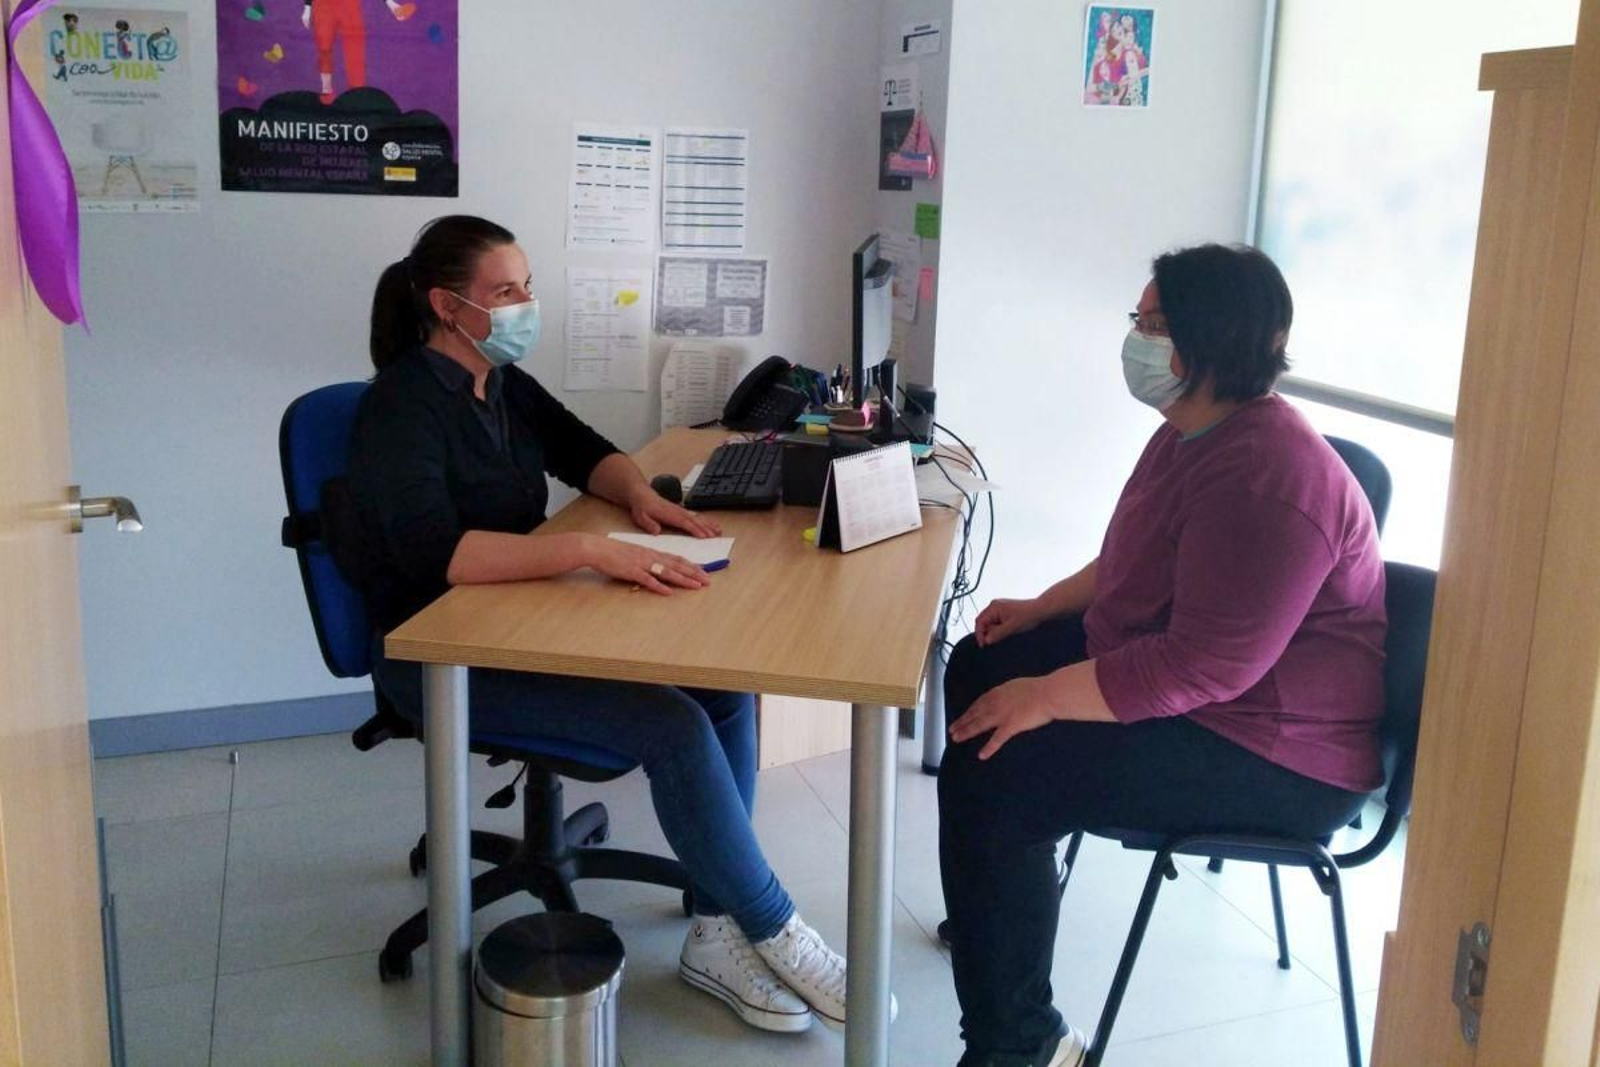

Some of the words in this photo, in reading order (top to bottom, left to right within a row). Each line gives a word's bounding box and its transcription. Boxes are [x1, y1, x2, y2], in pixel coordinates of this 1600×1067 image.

[110, 61, 160, 81] VIDA
[237, 119, 369, 142] MANIFIESTO
[259, 142, 275, 152] DE
[277, 142, 293, 153] LA
[278, 168, 323, 179] MENTAL
